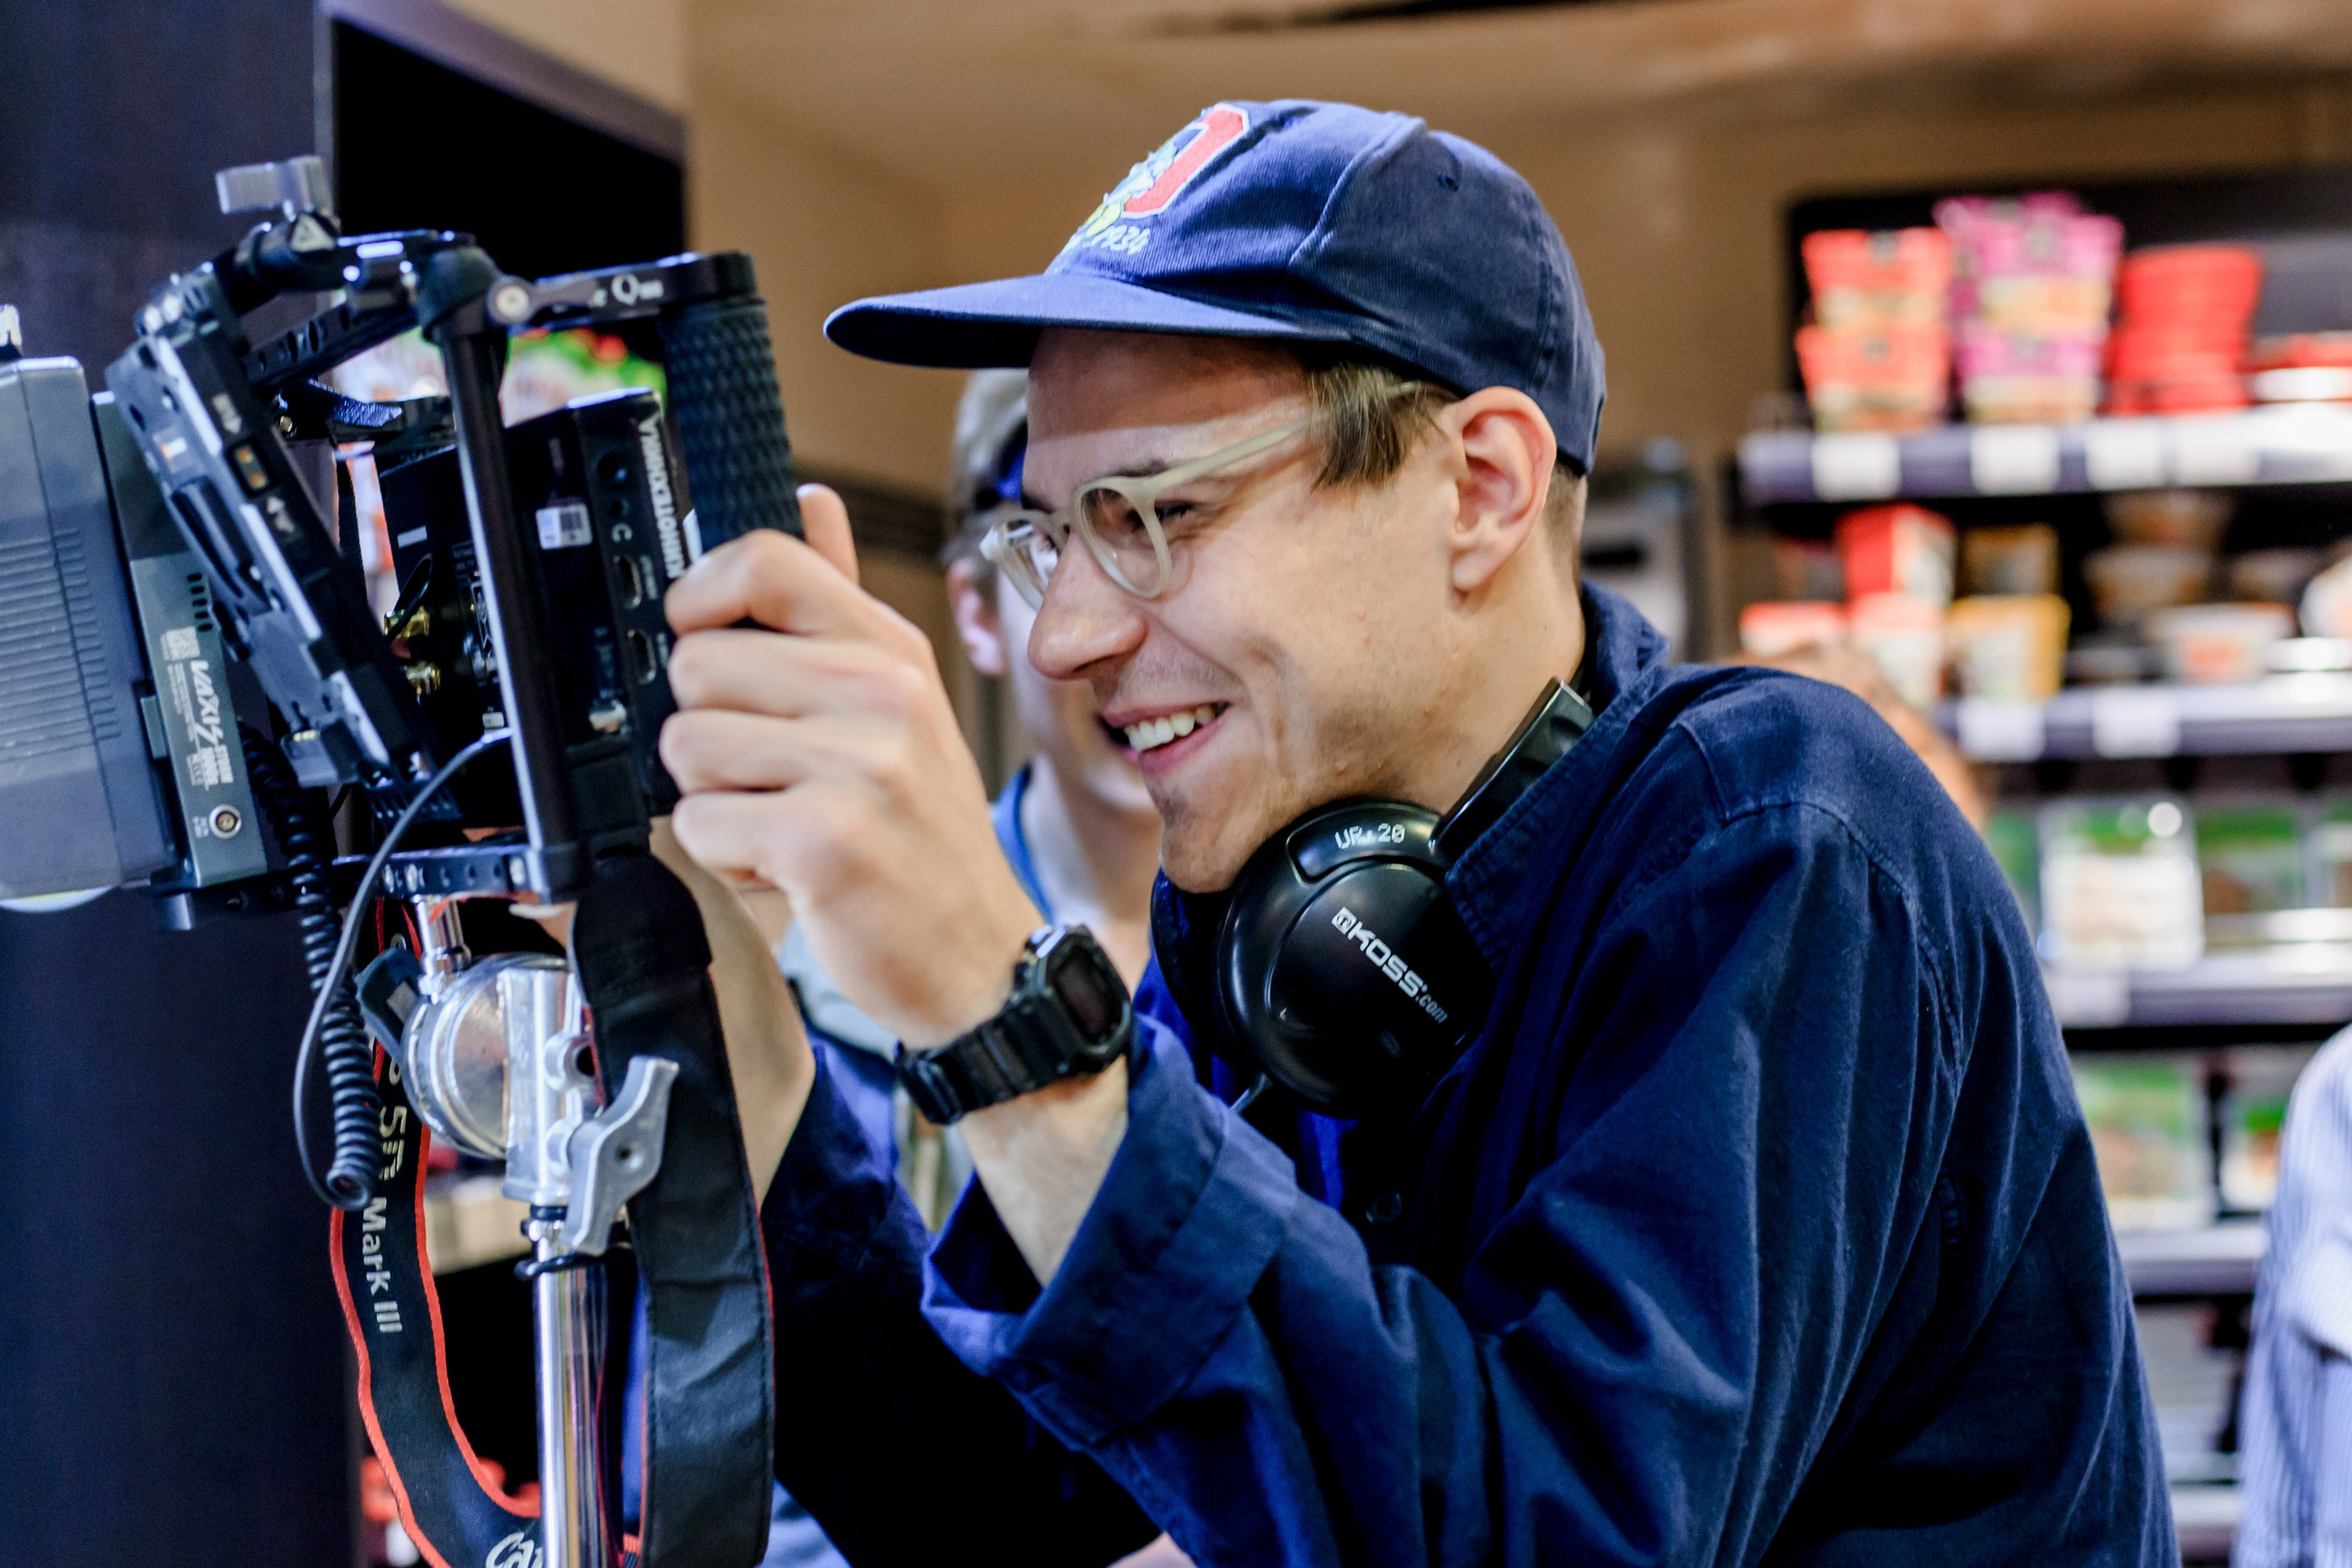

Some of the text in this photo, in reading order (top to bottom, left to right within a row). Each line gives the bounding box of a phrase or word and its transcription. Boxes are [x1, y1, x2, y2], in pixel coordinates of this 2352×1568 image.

[190, 660, 224, 746] VAXIS
[362, 1196, 391, 1297] Mark
[374, 1300, 403, 1333] III
